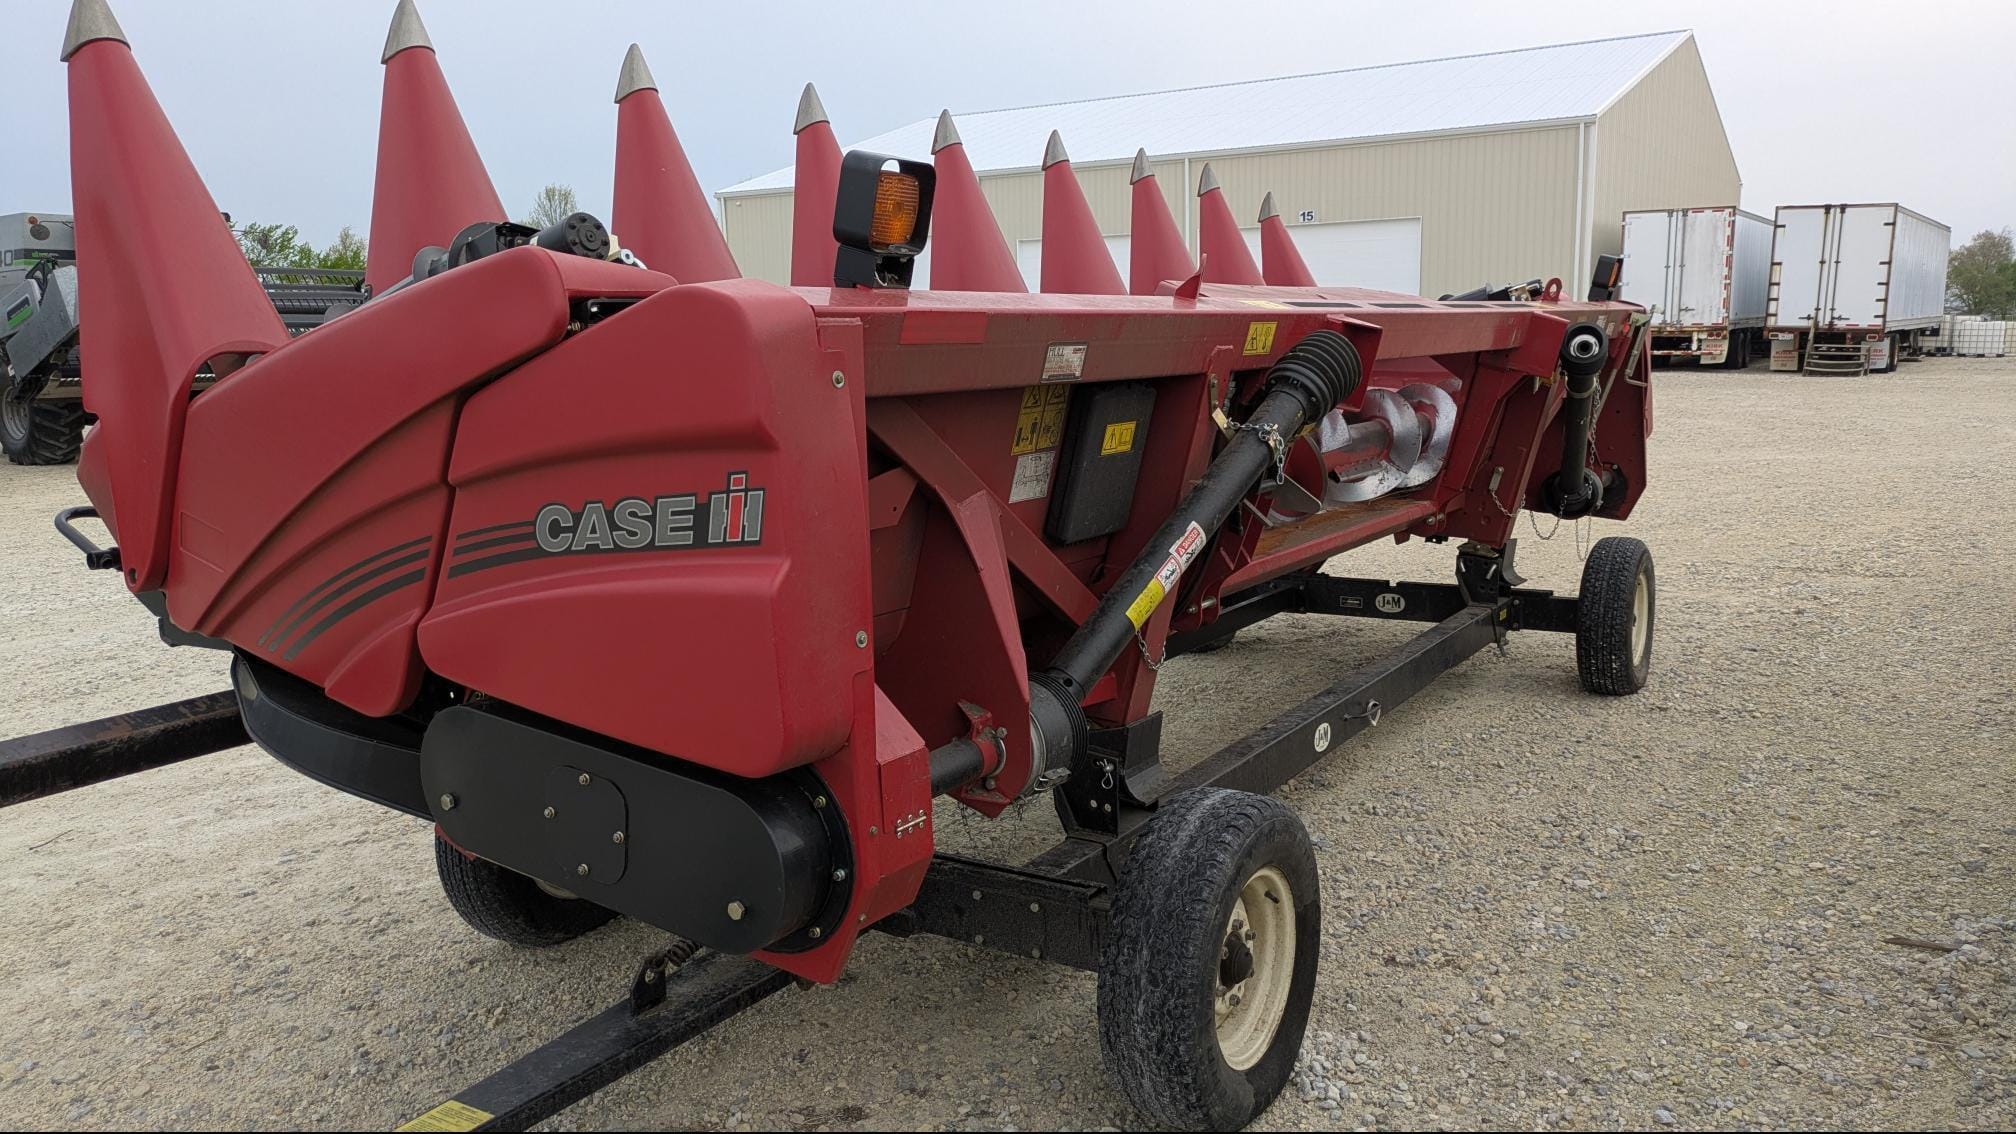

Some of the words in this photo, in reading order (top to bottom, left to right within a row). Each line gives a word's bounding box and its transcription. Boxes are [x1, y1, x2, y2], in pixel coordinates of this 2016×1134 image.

[1299, 211, 1314, 222] 15
[535, 496, 695, 552] CASE
[1183, 528, 1199, 548] DANGER
[1378, 595, 1401, 609] J&M
